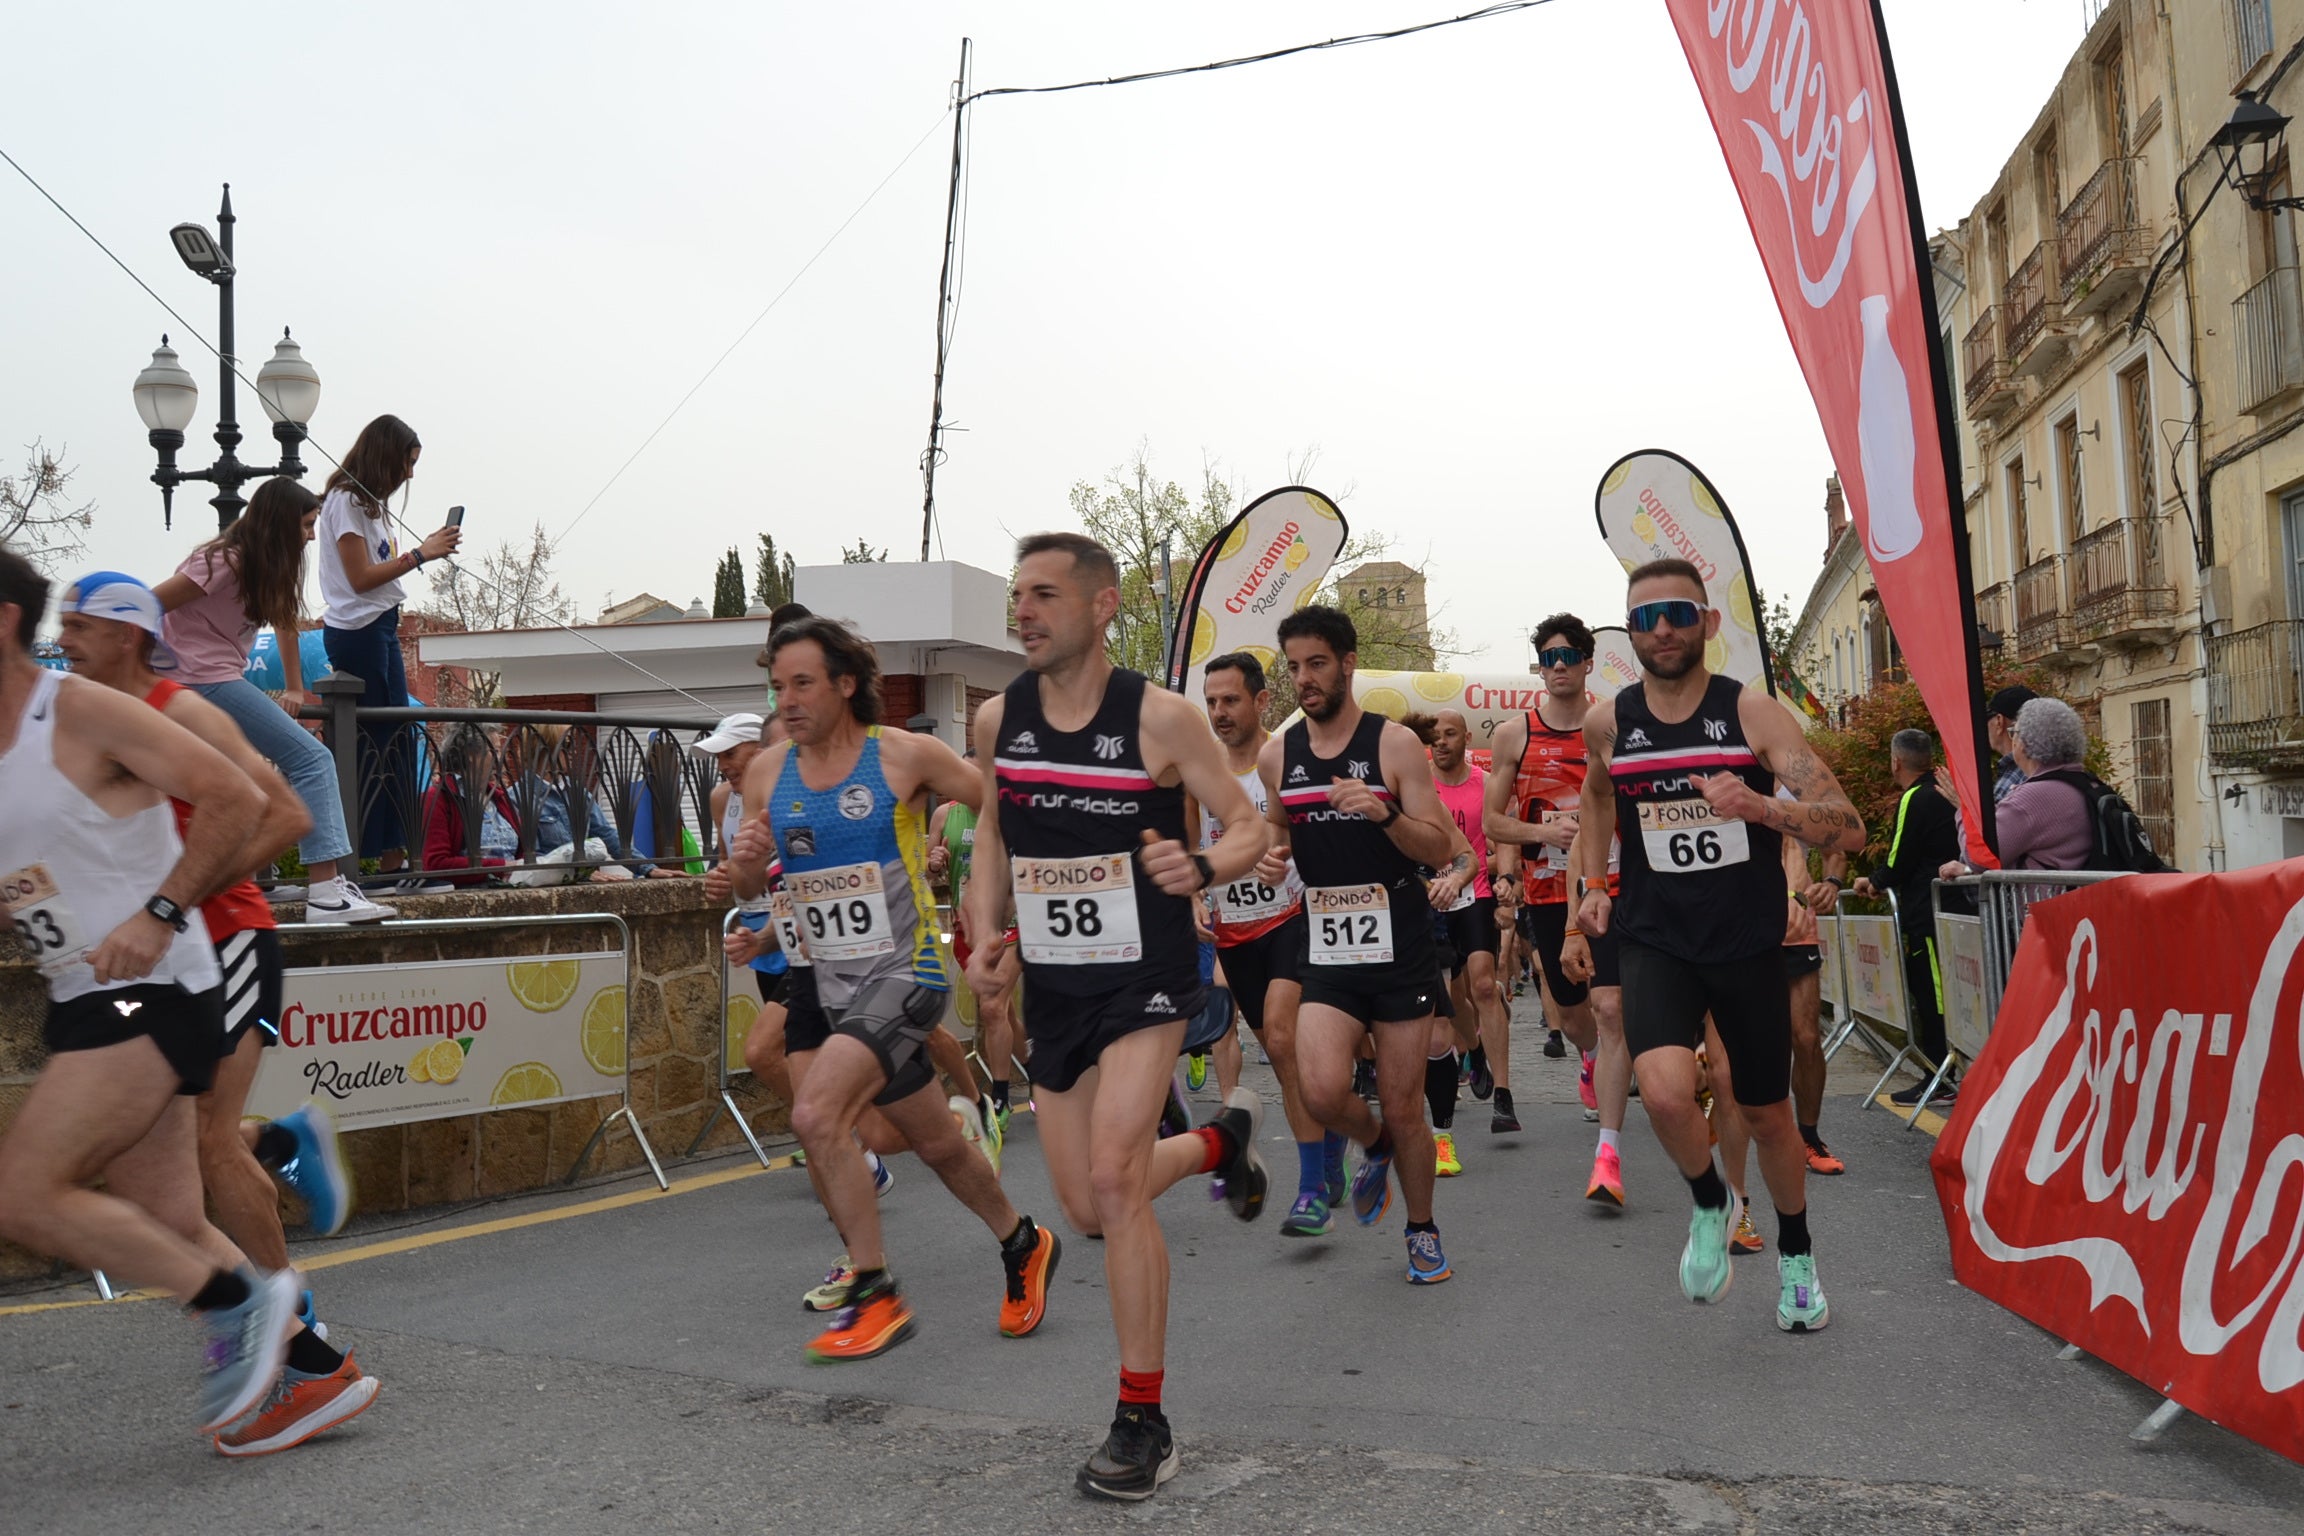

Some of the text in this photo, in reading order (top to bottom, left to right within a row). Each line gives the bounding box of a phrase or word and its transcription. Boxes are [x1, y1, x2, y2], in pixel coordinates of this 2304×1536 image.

[1225, 520, 1299, 614] Cruzcampo
[1251, 571, 1292, 616] Radler
[1669, 830, 1722, 868] 66
[803, 873, 861, 894] FONDO
[1034, 866, 1106, 885] FONDO
[1226, 881, 1276, 908] 456
[1047, 898, 1102, 937] 58
[1322, 892, 1372, 907] FONDO
[806, 900, 872, 939] 919
[1323, 915, 1379, 946] 512
[281, 1000, 487, 1048] Cruzcampo
[303, 1056, 408, 1100] Radler
